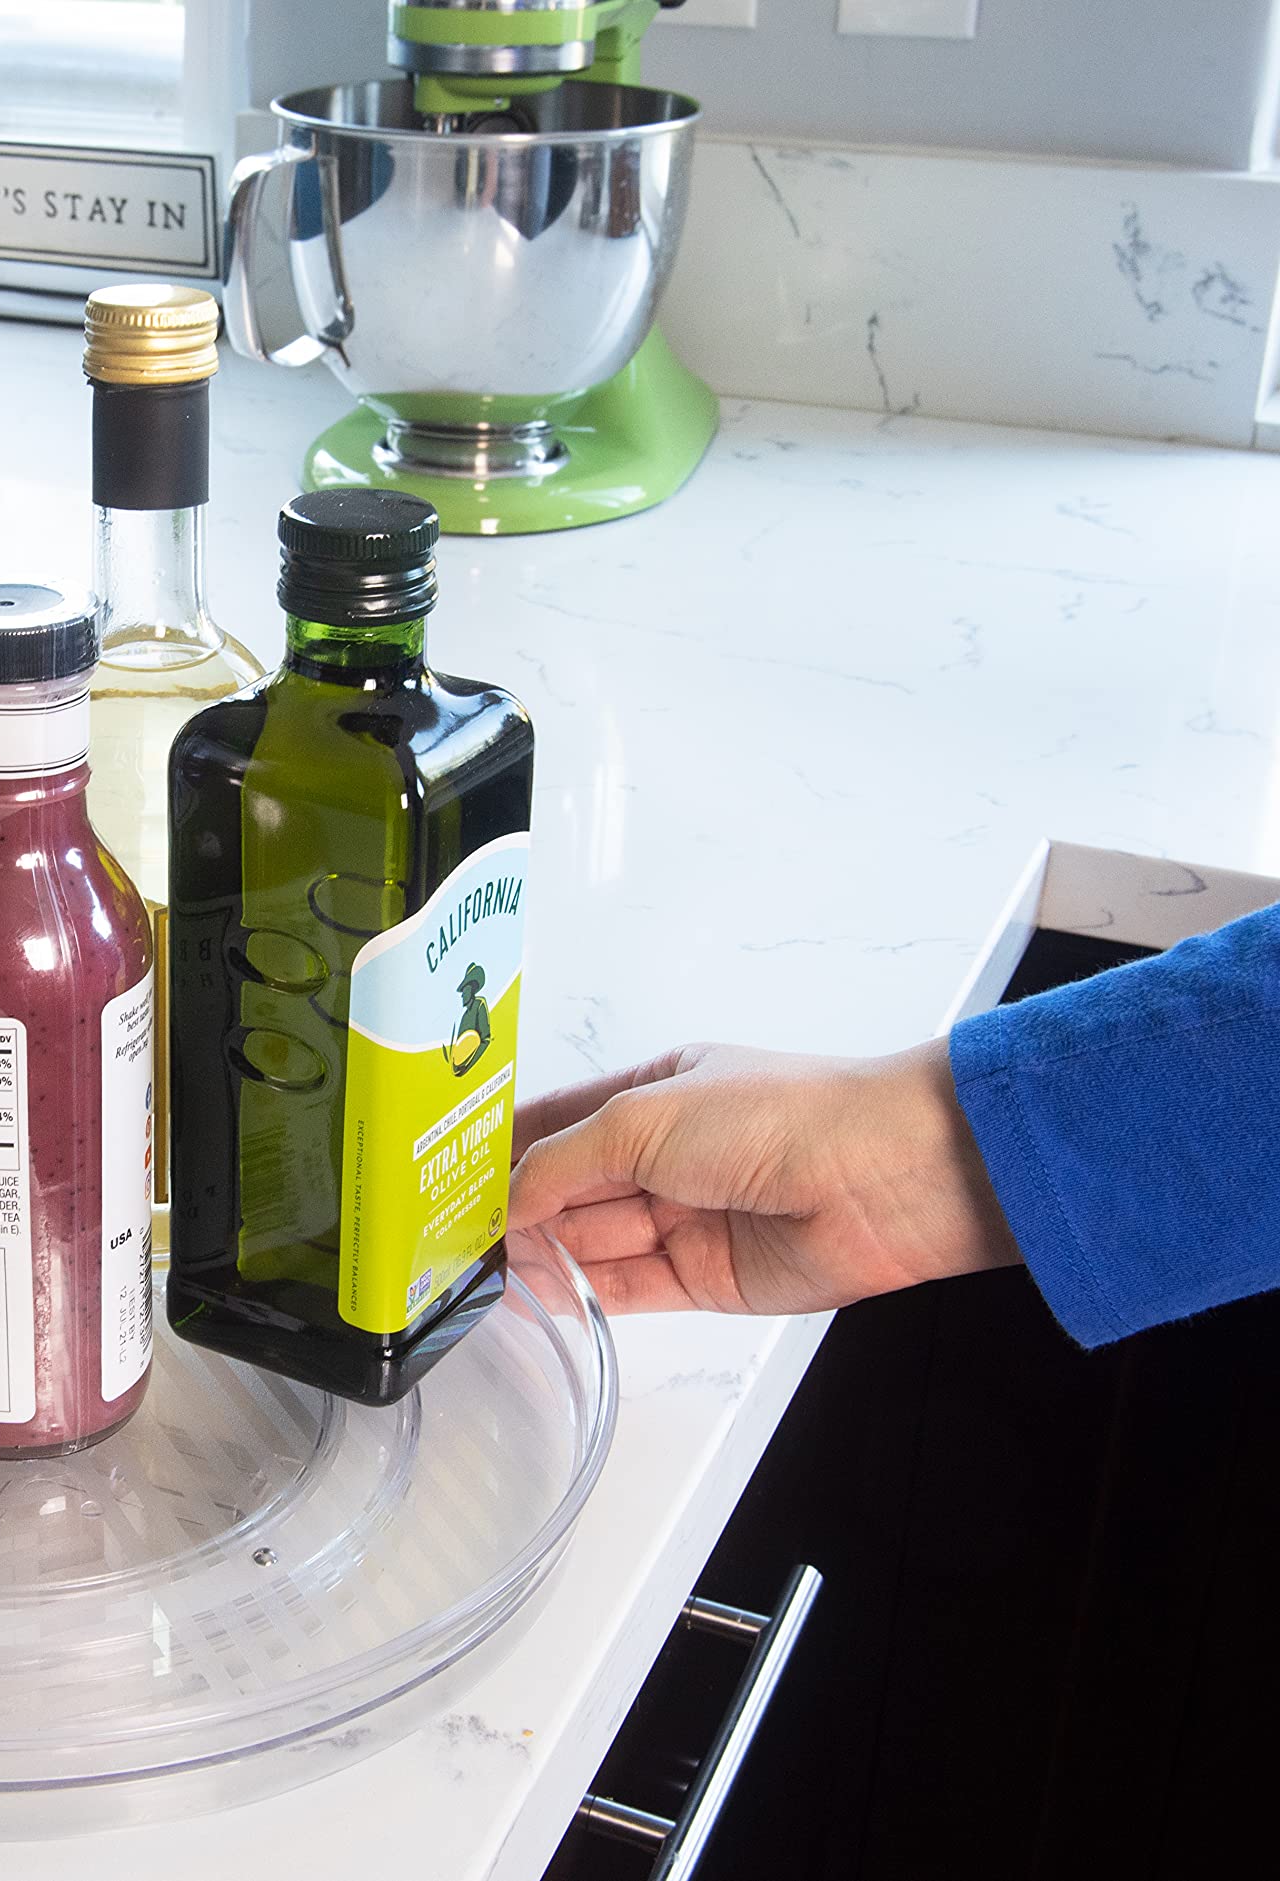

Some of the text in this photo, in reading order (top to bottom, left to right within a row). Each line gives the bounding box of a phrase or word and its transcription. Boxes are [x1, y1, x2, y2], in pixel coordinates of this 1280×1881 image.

[43, 190, 128, 224] STAY
[147, 200, 188, 231] IN
[426, 877, 523, 973] CALIFORNIA
[118, 1006, 139, 1026] Shake
[0, 1035, 12, 1043] DV
[420, 1098, 504, 1194] EXTRA VIRGIN
[431, 1142, 490, 1201] OLIVE OIL
[1, 1212, 20, 1223] TEA
[349, 1119, 365, 1312] EXCEPTIONAL TASTE, PERFECTLY BALANCED
[423, 1167, 495, 1238] EVERYDAY BLEND
[436, 1194, 481, 1239] COLD PRESSED
[110, 1228, 132, 1250] USA
